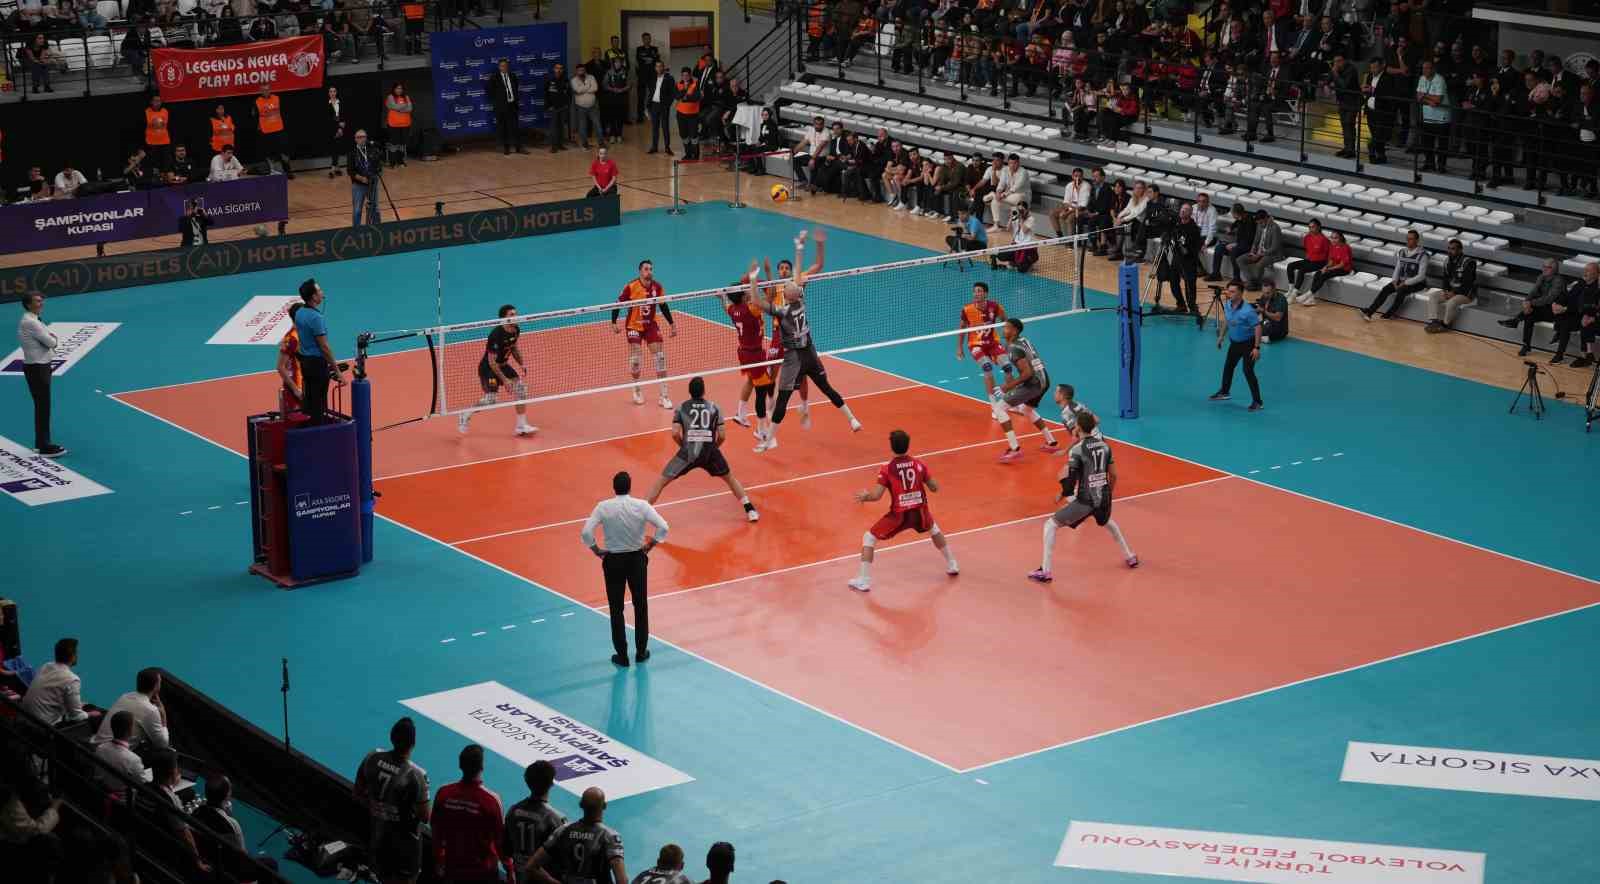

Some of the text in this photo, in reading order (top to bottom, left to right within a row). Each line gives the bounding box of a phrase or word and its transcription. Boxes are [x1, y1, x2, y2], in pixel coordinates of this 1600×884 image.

[186, 53, 288, 74] LEGENDS NEVER
[198, 70, 278, 89] PLAY ALONE
[34, 207, 145, 232] ŞAMPİYONLAR
[224, 201, 262, 215] SİGORTA
[67, 222, 114, 236] KUPASI
[97, 256, 181, 283] HOTELS
[247, 239, 327, 264] HOTELS
[389, 223, 464, 247] HOTELS
[523, 207, 594, 229] HOTELS
[689, 409, 710, 428] 20
[1091, 448, 1105, 471] 17
[899, 468, 916, 491] 19
[467, 708, 562, 755] AXA SİGORTA
[496, 703, 632, 768] ŞAMPİYONLAR
[548, 716, 609, 745] KUPASI
[1370, 751, 1532, 775] SİGORTA
[378, 771, 392, 800] 7
[517, 821, 536, 852] 11
[573, 843, 585, 873] 9
[1080, 833, 1466, 873] VOLEYBOL FEDERASYONU
[1204, 855, 1333, 874] TÜRKİYE
